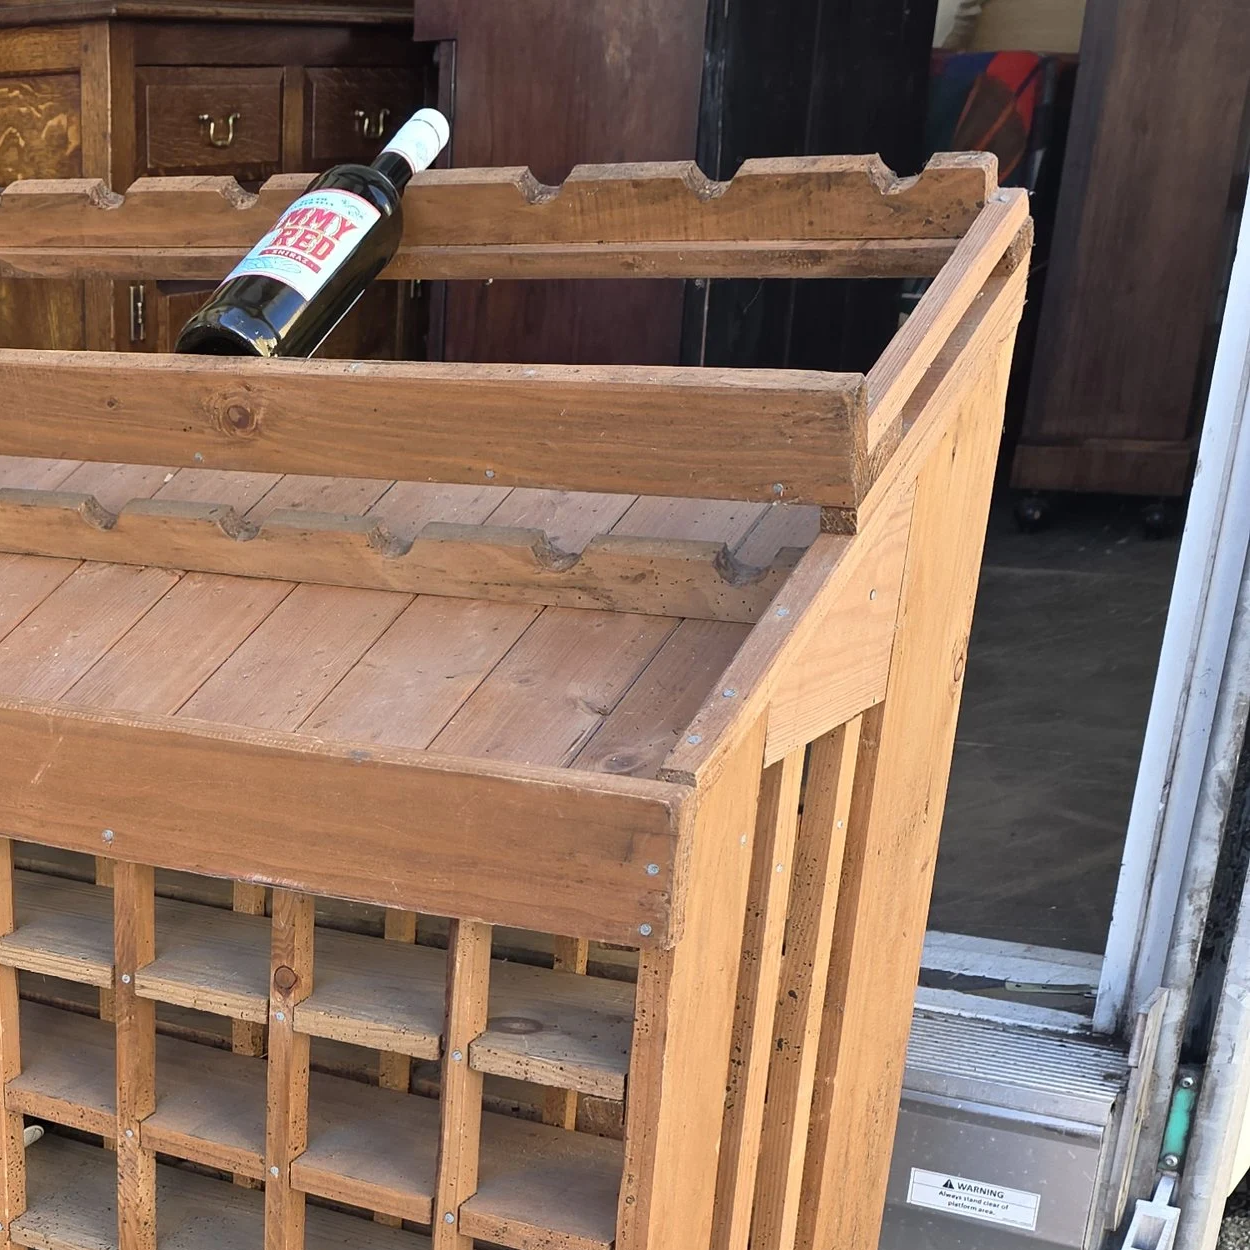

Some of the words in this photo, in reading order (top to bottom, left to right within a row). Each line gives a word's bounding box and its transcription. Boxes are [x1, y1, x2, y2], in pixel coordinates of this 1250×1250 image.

[275, 207, 358, 241] MMY
[270, 227, 336, 261] RED
[271, 248, 309, 266] SHIRAZ
[957, 1182, 1004, 1198] WARNING
[938, 1190, 962, 1200] Always
[963, 1195, 983, 1205] stand
[983, 1200, 1000, 1209] clear
[947, 1200, 978, 1212] platform
